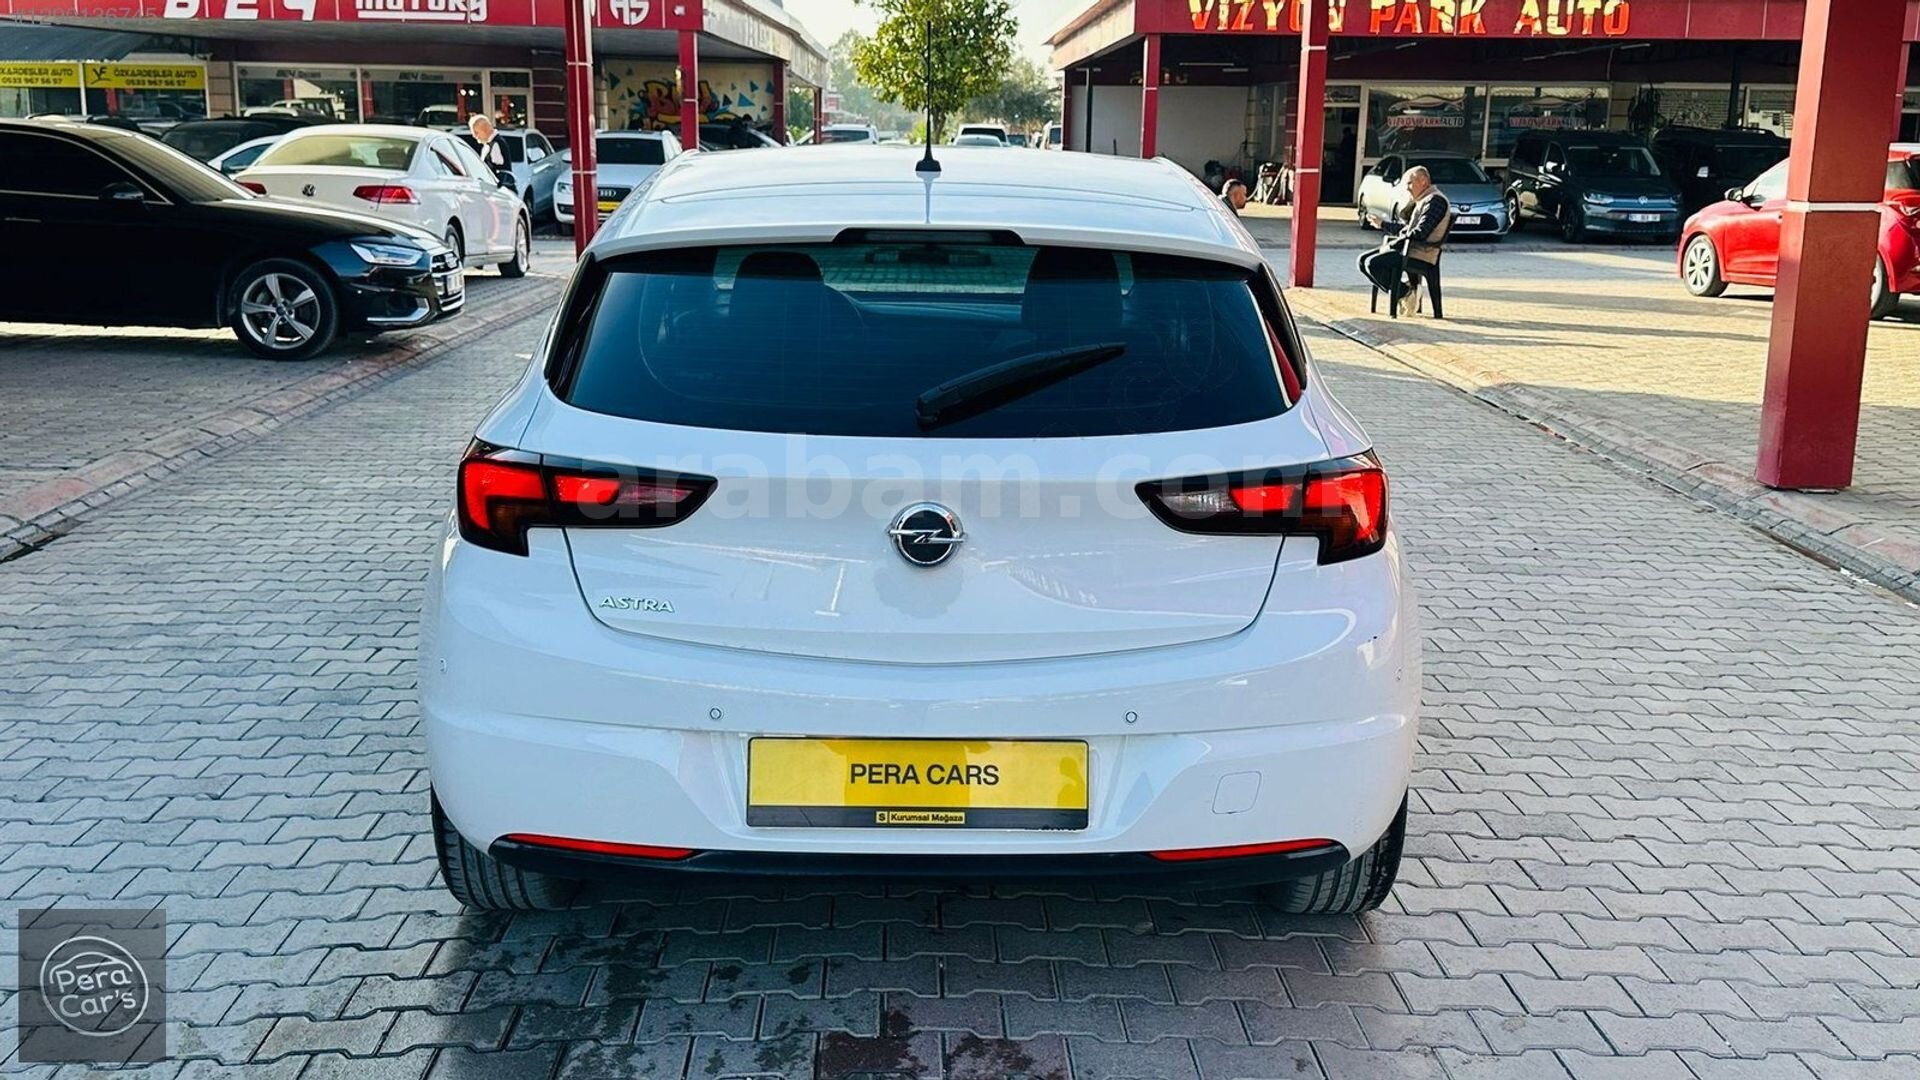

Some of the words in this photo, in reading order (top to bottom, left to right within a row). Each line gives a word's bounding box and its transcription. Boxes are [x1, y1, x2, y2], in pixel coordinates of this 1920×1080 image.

[1370, 0, 1486, 34] PARK
[1513, 0, 1630, 36] AUTO
[599, 595, 675, 613] ASTRA
[850, 763, 920, 785] PERA
[927, 763, 999, 786] CARS
[878, 812, 886, 822] S
[891, 812, 930, 822] Kurumsal
[931, 812, 963, 823] Mağaza
